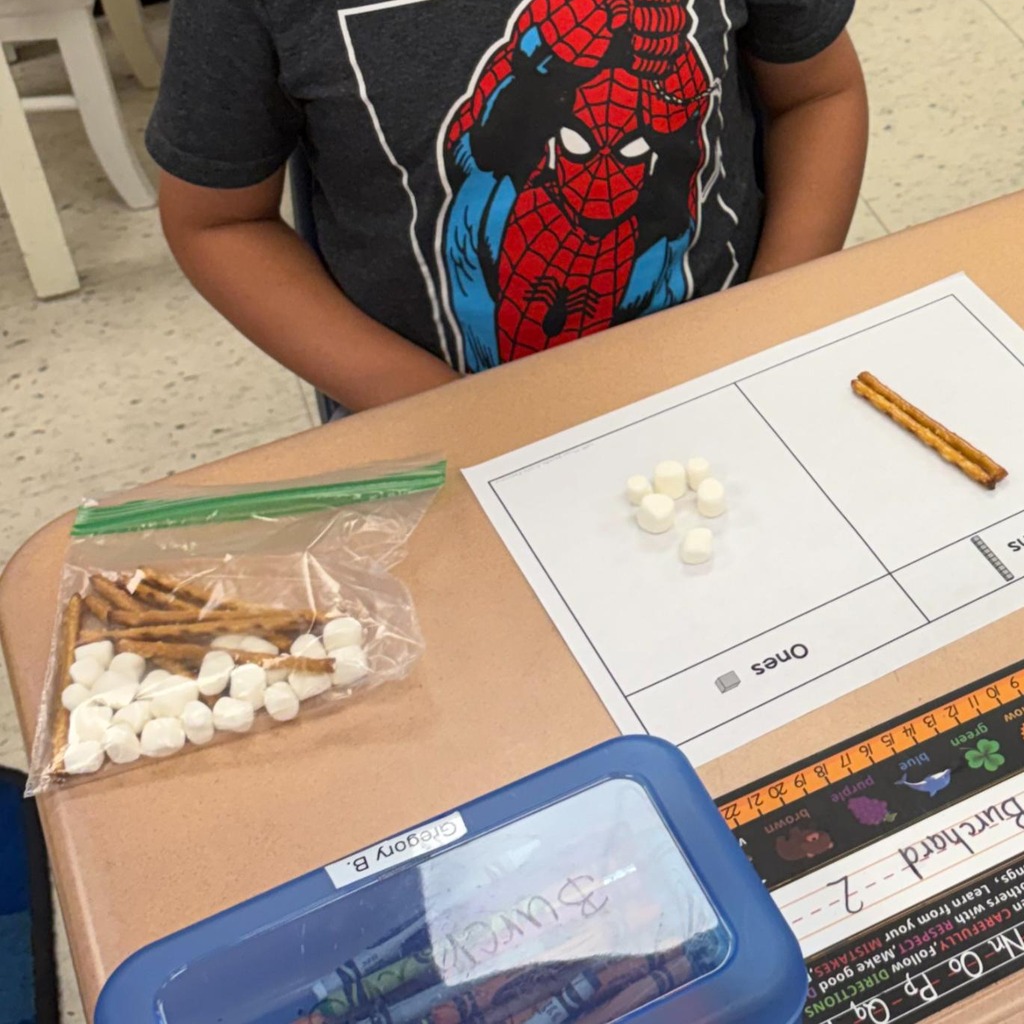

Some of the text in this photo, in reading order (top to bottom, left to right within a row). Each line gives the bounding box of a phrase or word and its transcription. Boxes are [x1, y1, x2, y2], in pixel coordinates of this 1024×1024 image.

[750, 642, 809, 676] Ones
[982, 682, 1002, 700] 10
[1010, 676, 1019, 688] 9
[967, 694, 979, 708] 11
[922, 713, 937, 730] 13
[943, 704, 961, 720] 12
[878, 731, 897, 749] 15
[902, 723, 916, 736] 14
[950, 722, 987, 746] green
[840, 752, 851, 768] 17
[857, 743, 875, 759] 16
[810, 761, 830, 780] 18
[895, 752, 929, 775] blue
[790, 770, 806, 787] 19
[747, 790, 763, 809] 21
[764, 779, 787, 801] 20
[830, 774, 878, 805] purple
[719, 801, 740, 822] 22
[764, 808, 810, 833] brown
[346, 819, 459, 873] Gregory B.
[951, 884, 990, 907] Learn
[916, 904, 950, 924] from
[954, 904, 985, 923] with
[885, 917, 915, 941] your
[947, 950, 983, 978] Oo
[818, 965, 853, 993] good
[903, 971, 938, 1002] Pp
[804, 968, 889, 1017] DIRECTIONS
[849, 997, 890, 1024] Qq
